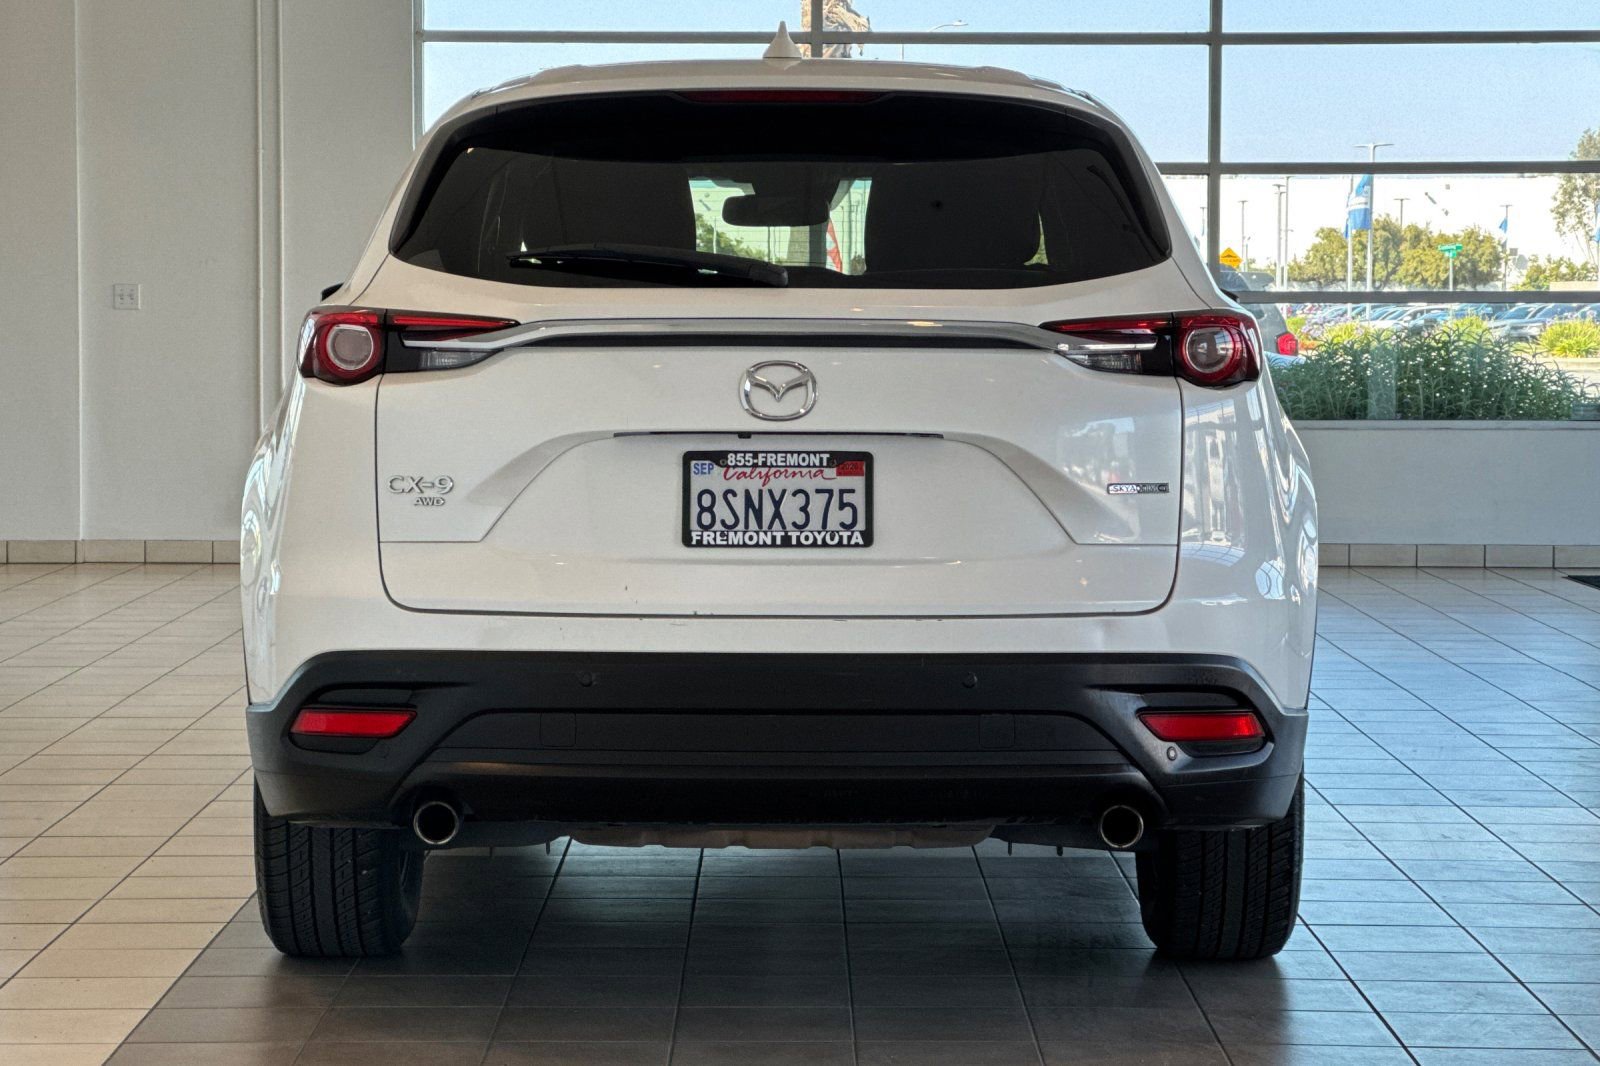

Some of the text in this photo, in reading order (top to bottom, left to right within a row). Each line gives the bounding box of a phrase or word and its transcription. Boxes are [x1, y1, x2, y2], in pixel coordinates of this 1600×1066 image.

[727, 453, 830, 466] 855-FREMONT
[693, 463, 714, 475] SEP
[723, 465, 836, 487] California
[388, 475, 454, 494] CX-9
[414, 497, 445, 506] AWD
[697, 488, 857, 530] 8SNX375
[691, 531, 864, 545] FREMONT TOYOTA
